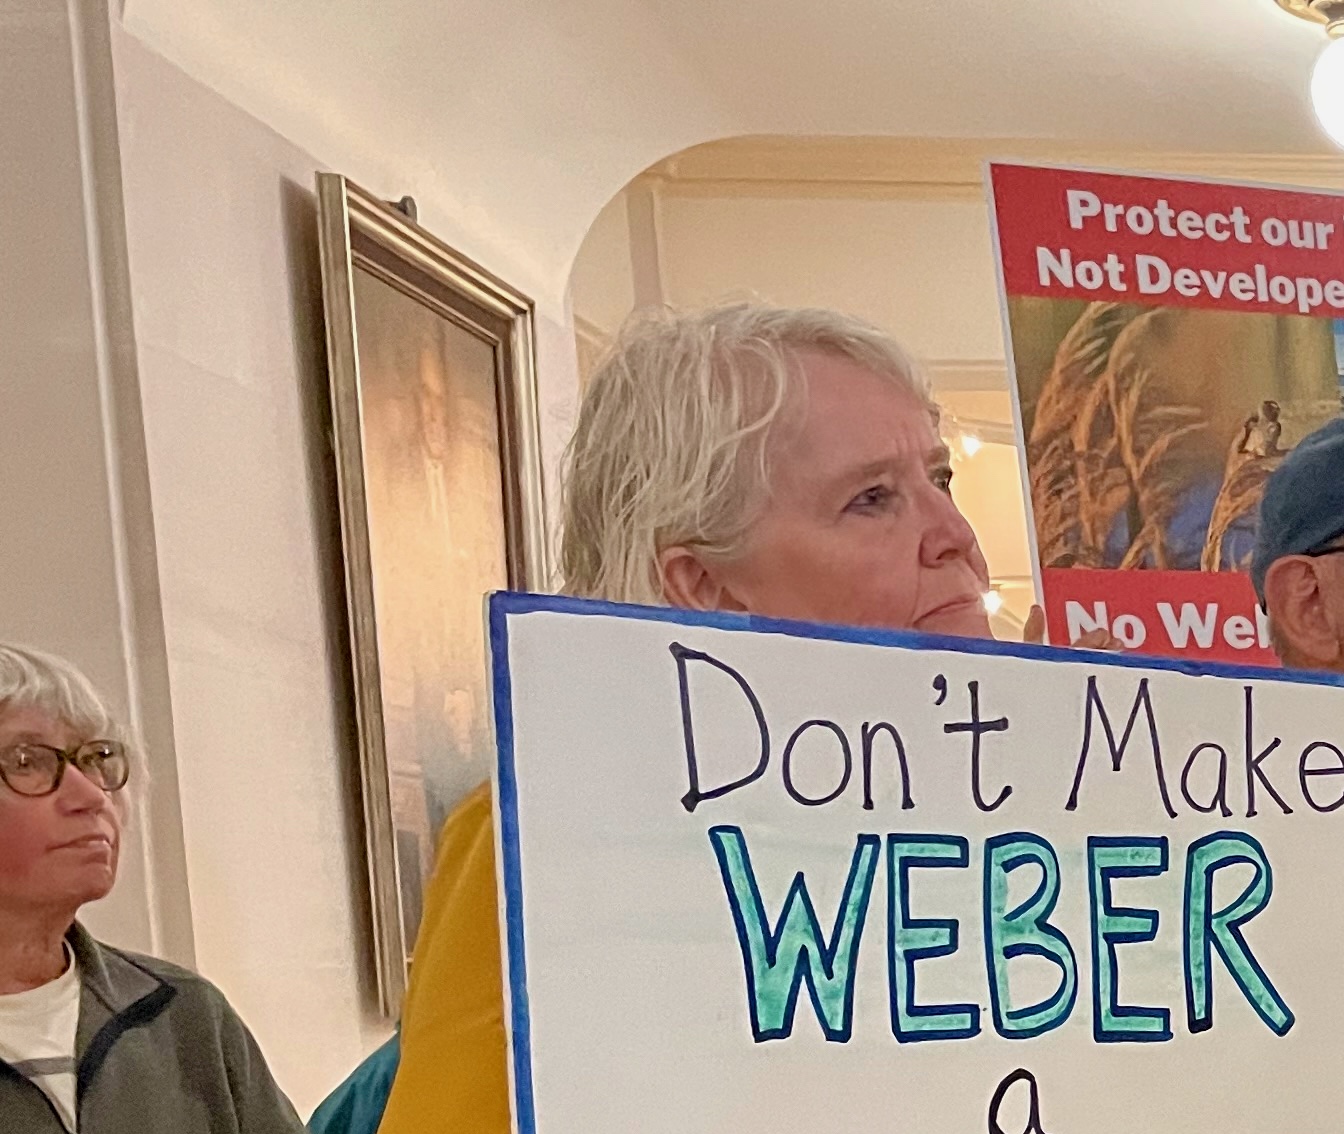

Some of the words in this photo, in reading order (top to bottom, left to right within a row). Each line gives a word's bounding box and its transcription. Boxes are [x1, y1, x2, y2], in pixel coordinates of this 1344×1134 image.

[1067, 189, 1251, 244] Protect
[1262, 218, 1334, 250] our
[1037, 247, 1127, 292] Not
[1065, 600, 1146, 649] No
[669, 642, 1012, 813] Don't
[710, 825, 1295, 1043] WEBER
